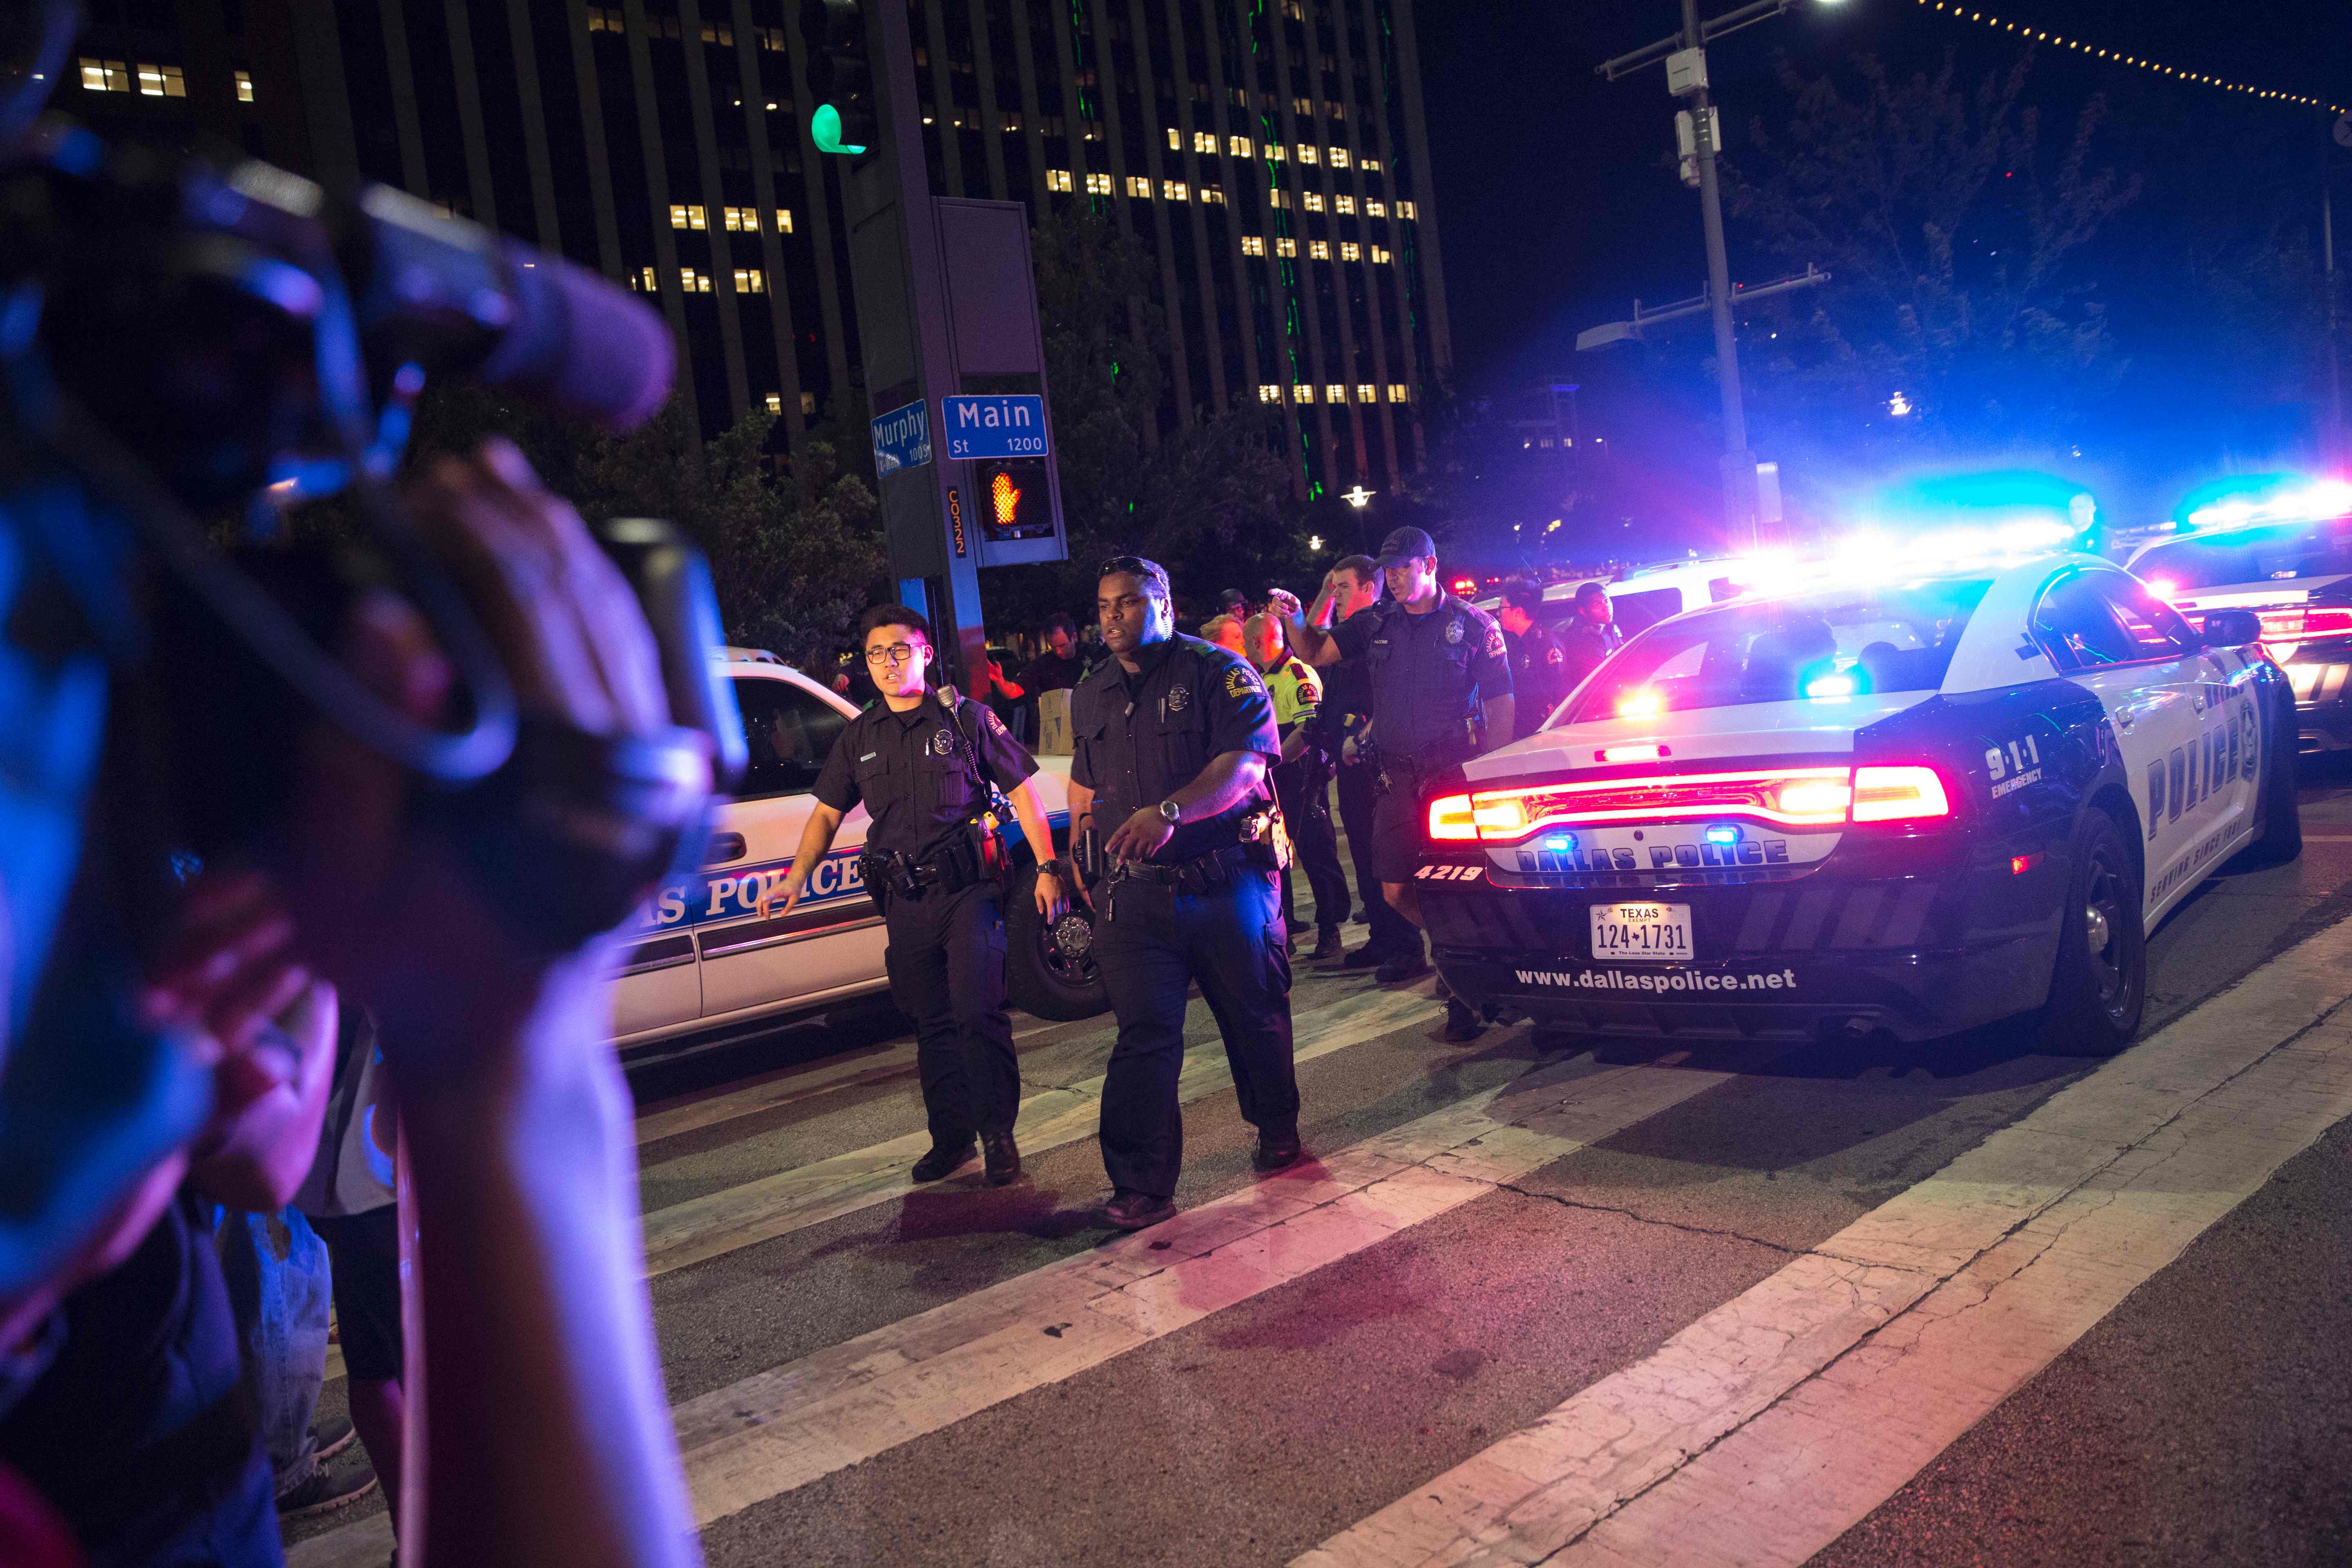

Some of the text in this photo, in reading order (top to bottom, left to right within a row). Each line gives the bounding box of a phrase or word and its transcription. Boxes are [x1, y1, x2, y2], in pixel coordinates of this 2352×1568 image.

[958, 399, 1031, 428] Main
[874, 410, 924, 449] Murphy
[953, 437, 1042, 454] St 1200
[1225, 668, 1261, 690] DALLAS POLICE
[1991, 767, 2042, 800] EMERGENCY
[2147, 717, 2238, 842] POLICE
[1516, 839, 1789, 872] DALLAS POLICE
[1414, 865, 1483, 881] 4219
[1620, 908, 1659, 918] TEXAS
[1515, 969, 1797, 994] www.dallaspolice.net
